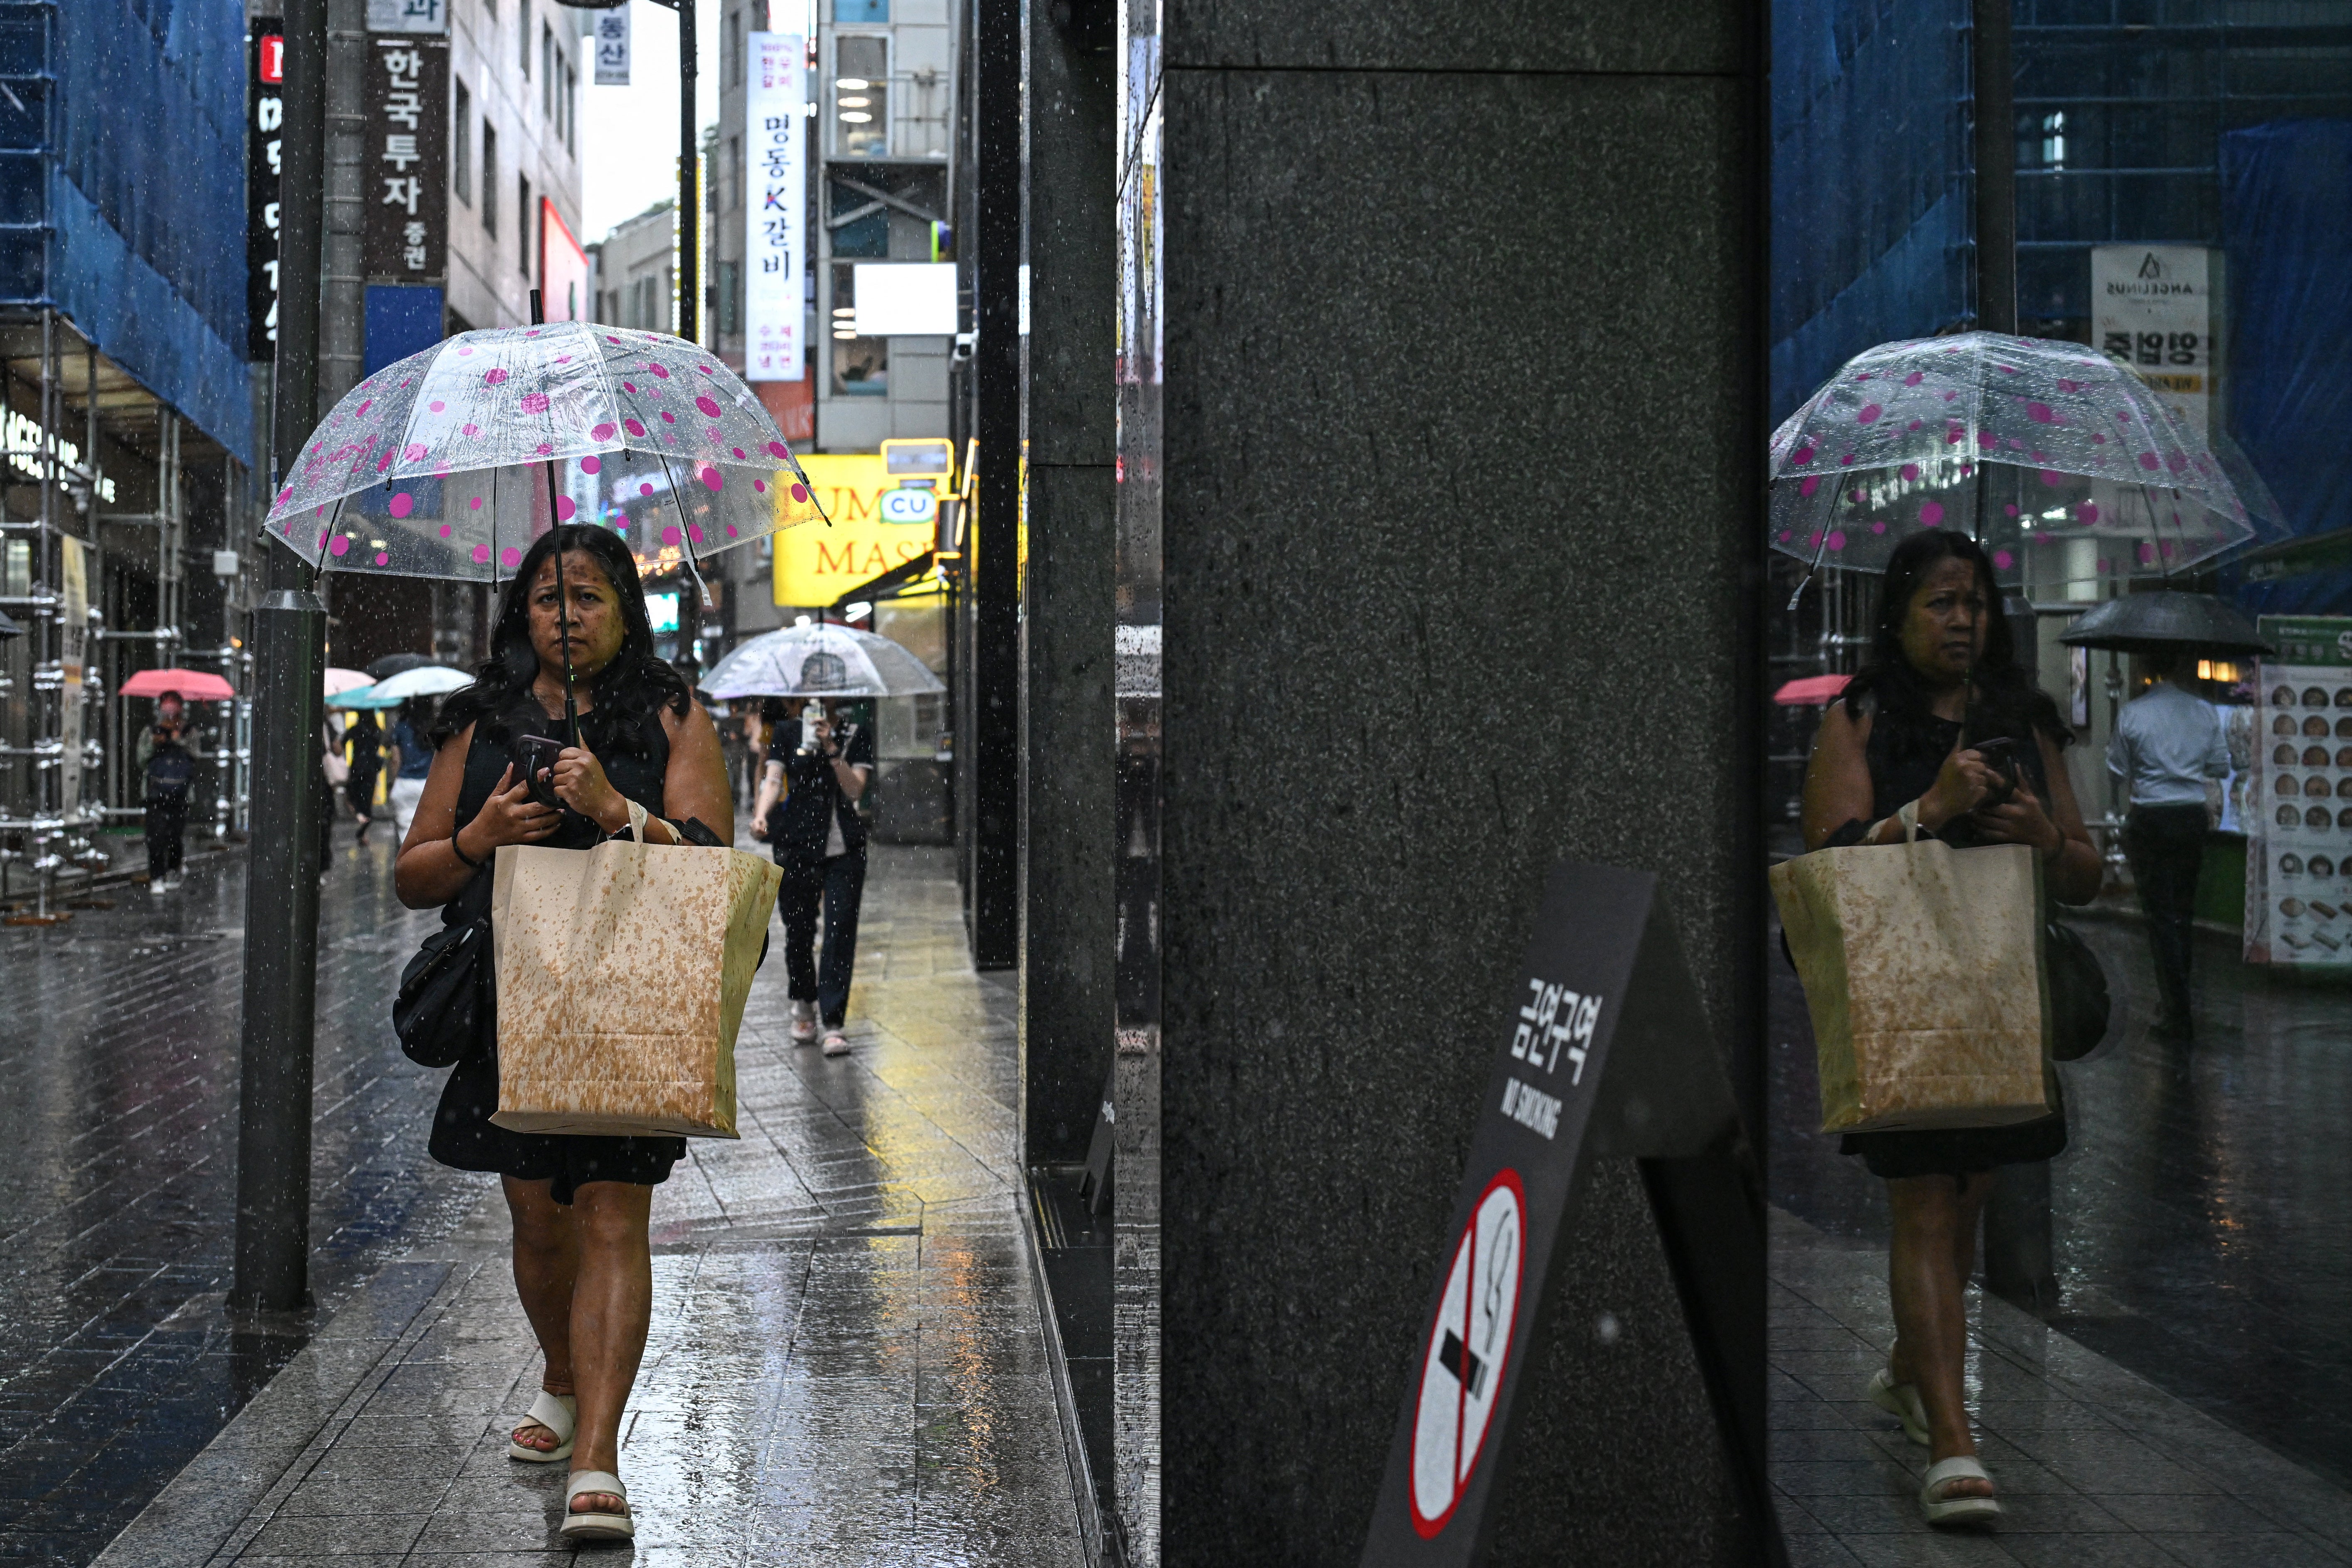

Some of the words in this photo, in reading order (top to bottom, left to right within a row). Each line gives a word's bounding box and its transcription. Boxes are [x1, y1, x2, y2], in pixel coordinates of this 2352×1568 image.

[599, 8, 625, 66] 동산
[382, 50, 423, 215] 한국투자
[403, 221, 428, 271] 증권
[891, 497, 926, 513] CU
[813, 540, 935, 574] MAS
[1511, 977, 1604, 1086] 금연구역
